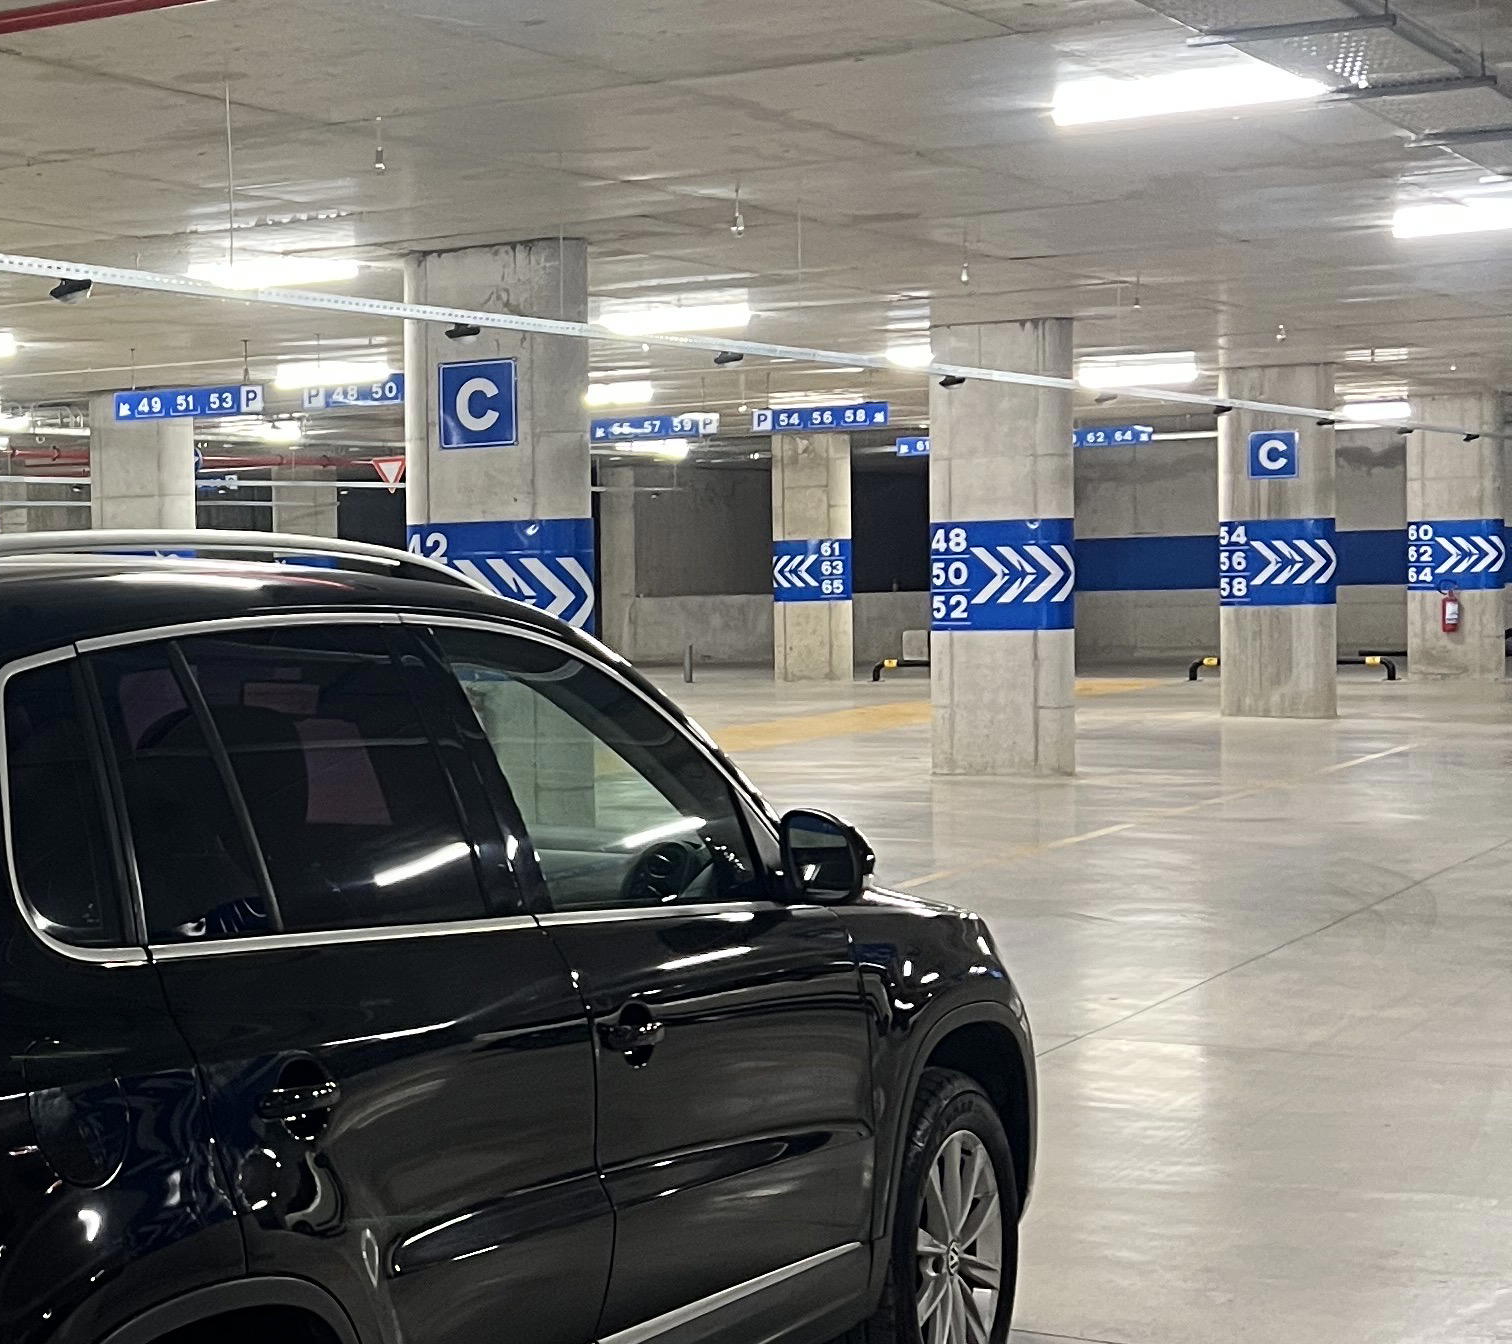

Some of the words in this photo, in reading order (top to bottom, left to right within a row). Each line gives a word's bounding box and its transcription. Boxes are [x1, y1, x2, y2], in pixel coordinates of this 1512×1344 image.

[332, 385, 358, 400] 48
[371, 382, 397, 398] 50
[137, 397, 162, 413] 49
[176, 395, 194, 411] 51
[209, 392, 233, 409] 53
[245, 390, 257, 408] P
[455, 377, 500, 431] C
[643, 420, 661, 433] 57
[672, 417, 692, 432] 59
[703, 417, 713, 430] P
[757, 413, 768, 428] P
[779, 413, 800, 426] 54
[812, 411, 833, 424] 56
[844, 409, 866, 422] 58
[1086, 431, 1105, 442] 62
[1114, 430, 1133, 441] 64
[1258, 439, 1288, 470] C
[931, 527, 967, 553] 48
[1219, 526, 1247, 545] 54
[1408, 524, 1433, 541] 60
[820, 541, 840, 557] 61
[1408, 545, 1433, 562] 62
[821, 560, 844, 576] 63
[1219, 551, 1247, 571] 56
[931, 561, 969, 586] 50
[1408, 567, 1433, 583] 64
[821, 579, 844, 594] 65
[1220, 577, 1248, 597] 58
[931, 595, 969, 619] 52
